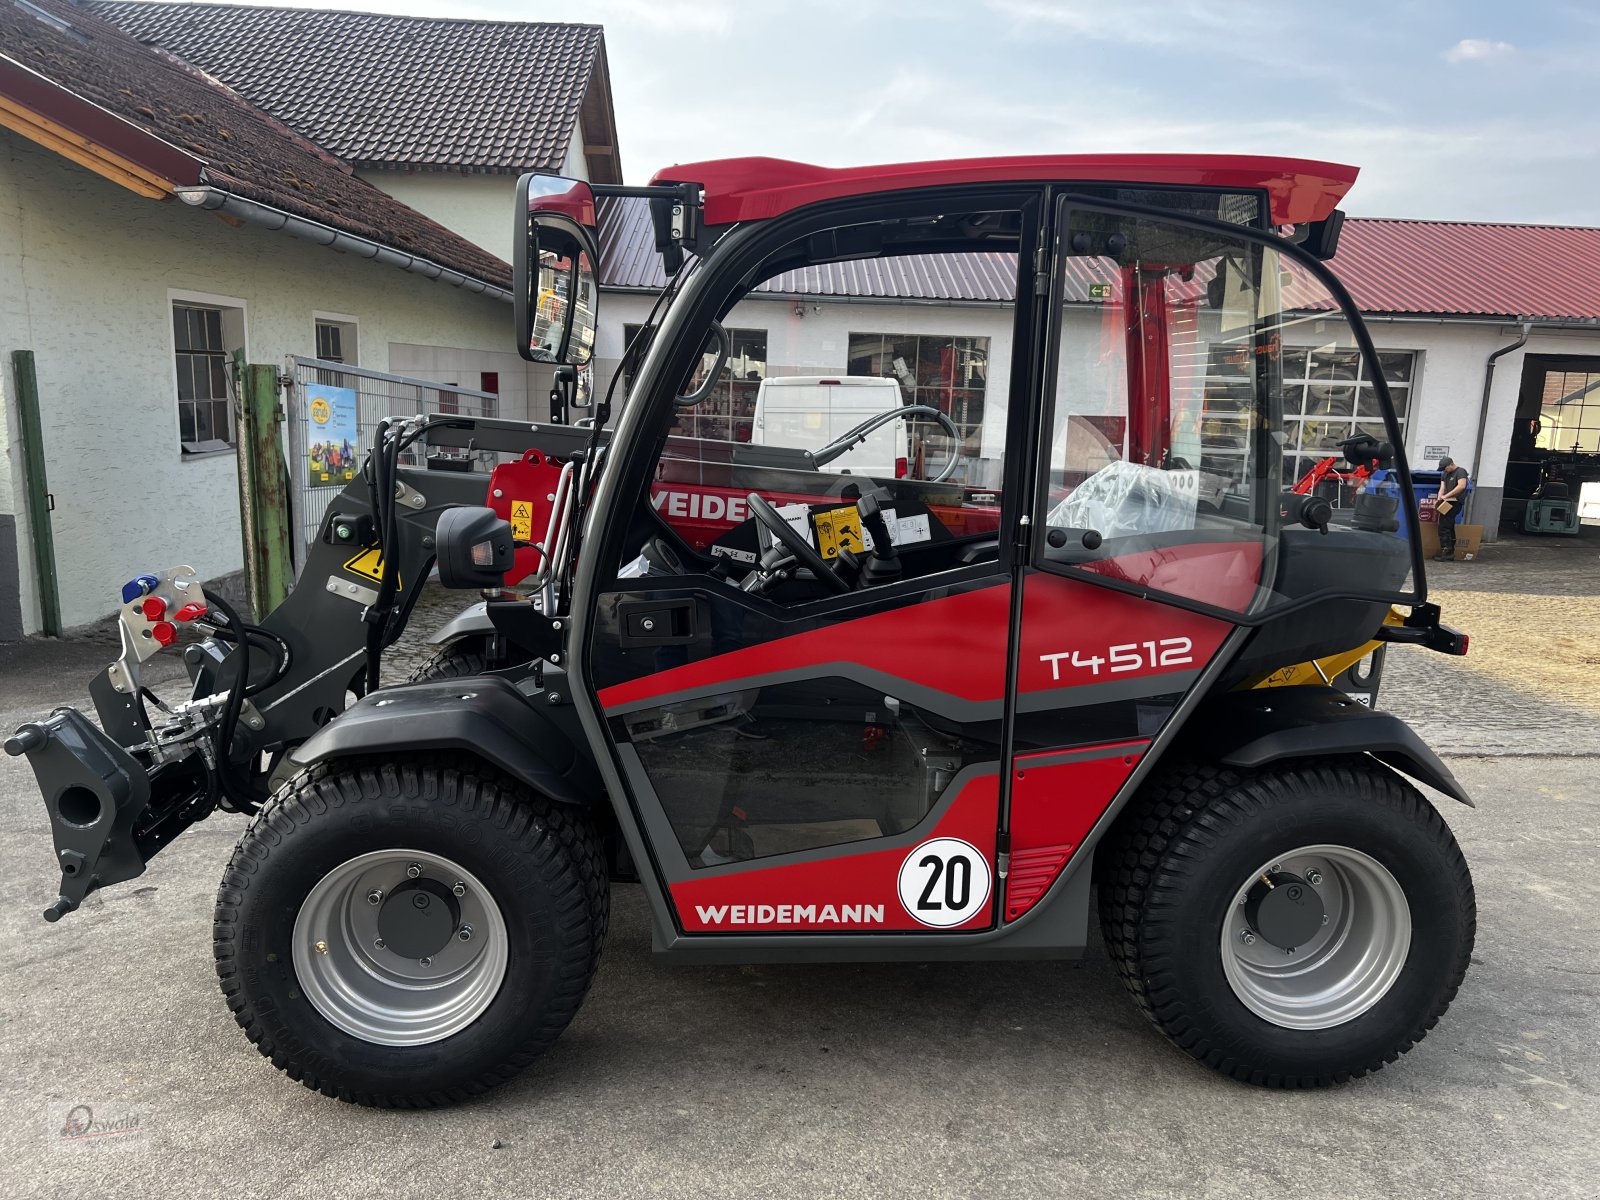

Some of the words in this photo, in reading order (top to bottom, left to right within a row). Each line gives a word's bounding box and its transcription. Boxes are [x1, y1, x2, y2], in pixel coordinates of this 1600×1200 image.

[1039, 636, 1193, 680] T4512
[917, 854, 972, 911] 20
[695, 904, 885, 925] WEIDEMANN
